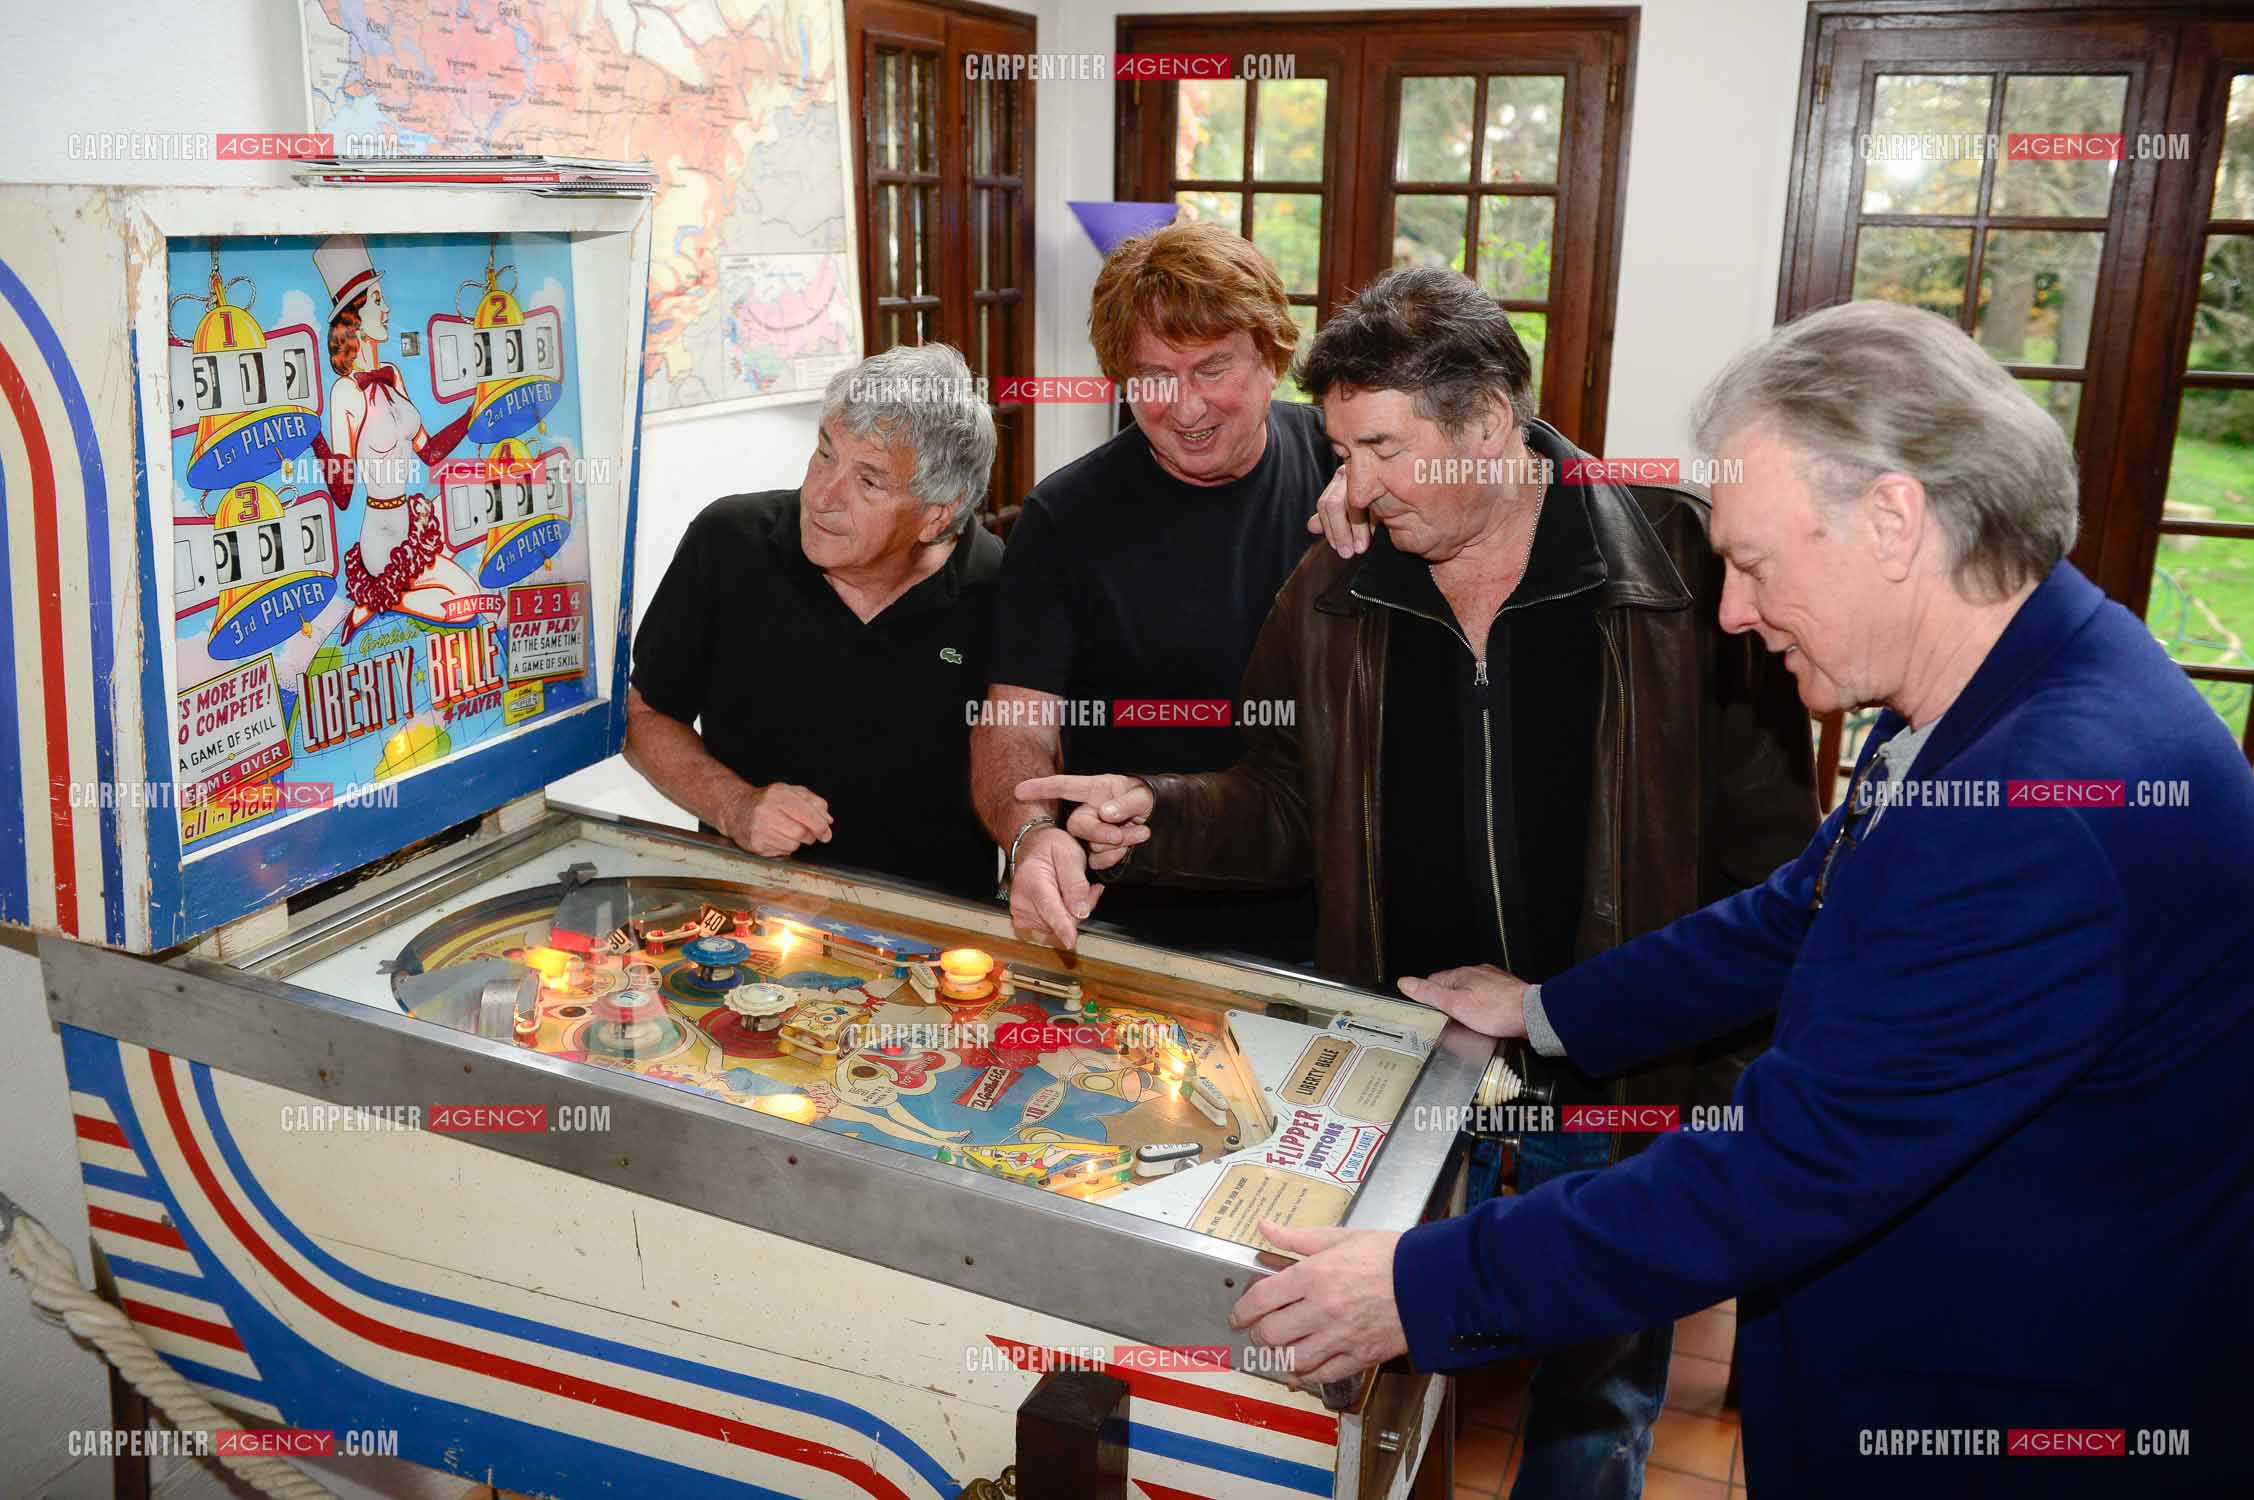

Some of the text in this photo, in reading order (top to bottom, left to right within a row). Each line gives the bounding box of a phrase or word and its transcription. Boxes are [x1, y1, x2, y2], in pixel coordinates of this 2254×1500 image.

[490, 295, 508, 325] 2
[220, 311, 237, 347] 1
[485, 383, 552, 427] 2nd PLAYER
[212, 416, 307, 471] 1st PLAYER
[235, 486, 260, 522] 3
[517, 523, 562, 558] PLAYER
[230, 582, 325, 647] 3rd PLAYER
[448, 597, 502, 618] PLAYERS
[515, 591, 580, 616] 1 2 3 4
[511, 632, 581, 653] AT THE SAME TIME
[512, 617, 580, 639] CAN PLAY
[513, 655, 579, 674] A GAME OF SKILL
[197, 678, 237, 713] MORE
[241, 663, 268, 693] FUN
[296, 622, 503, 753] LIBERTY BELLE
[178, 726, 190, 745] O
[179, 717, 277, 773] A GAME OF SKILL
[241, 746, 283, 775] OVER
[182, 808, 208, 840] all
[212, 810, 225, 825] in
[1296, 1047, 1340, 1097] LIBERTY BELLE
[1266, 1109, 1323, 1166] FLIPPER
[1305, 1122, 1345, 1170] BUTTONS
